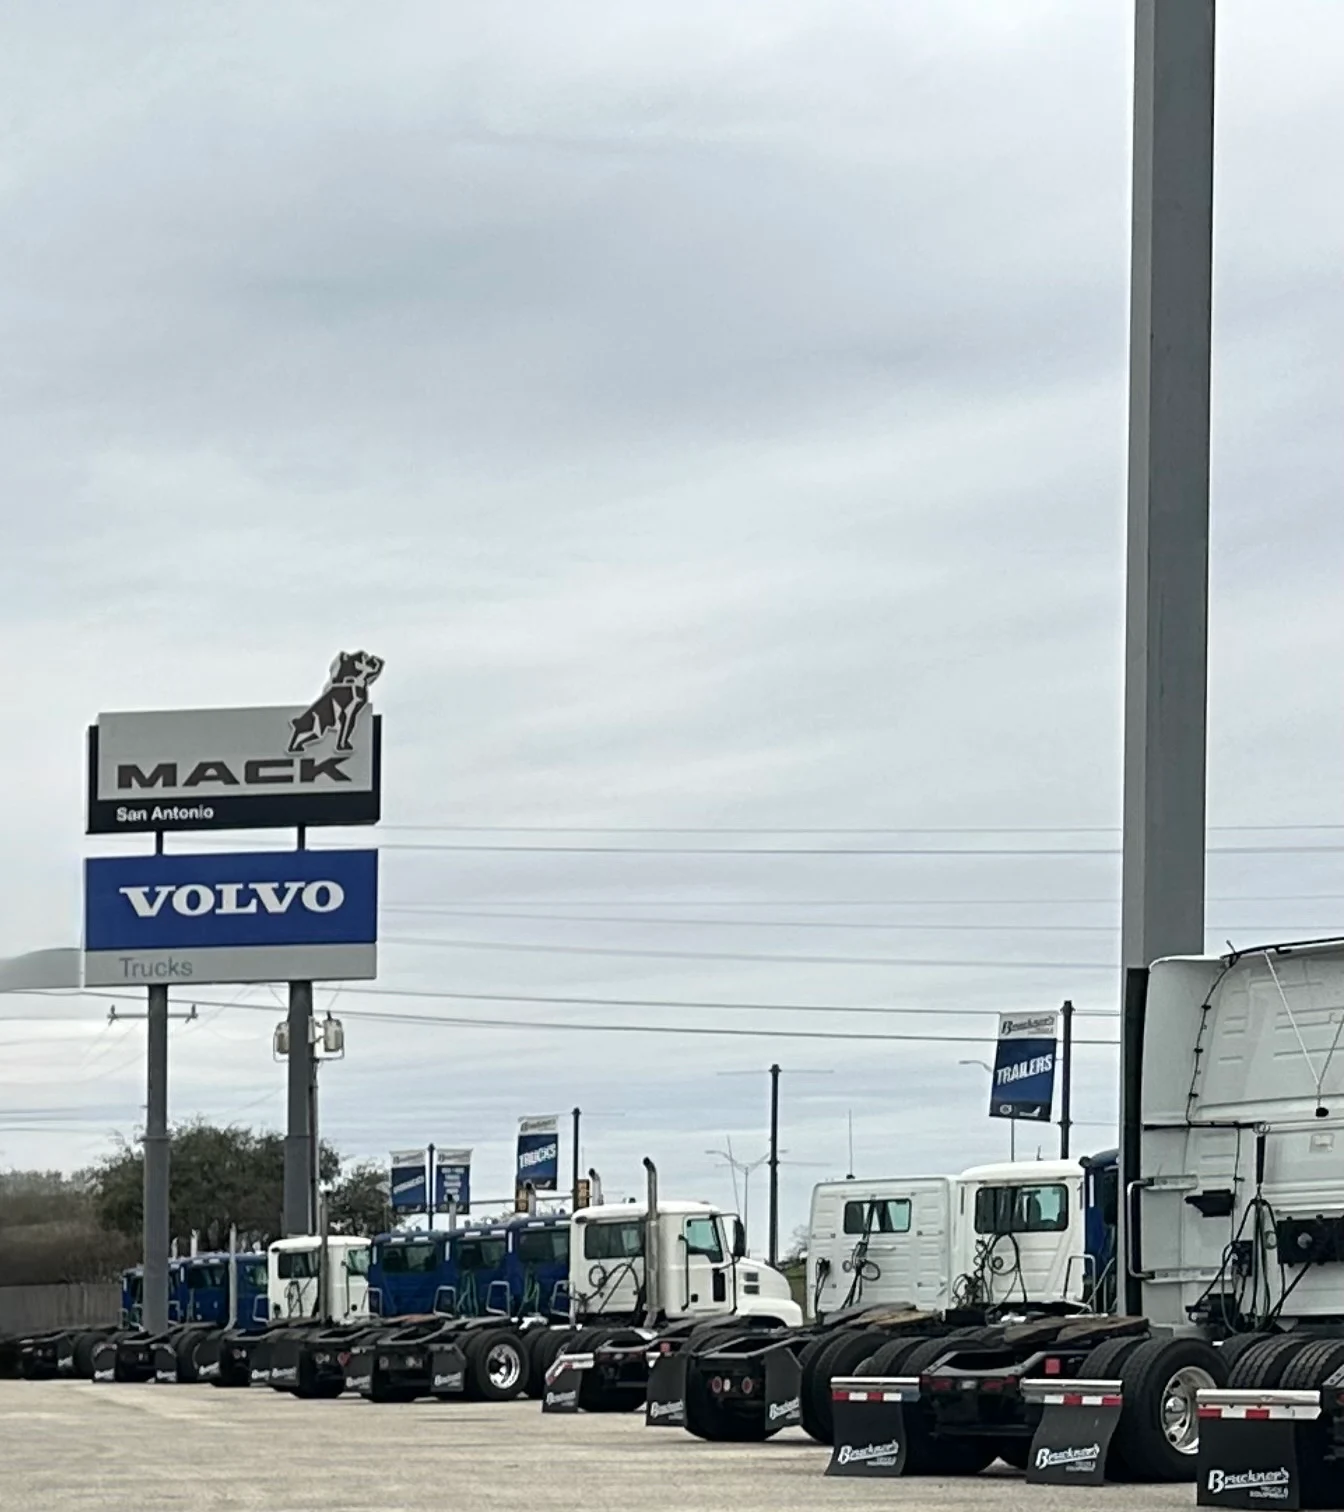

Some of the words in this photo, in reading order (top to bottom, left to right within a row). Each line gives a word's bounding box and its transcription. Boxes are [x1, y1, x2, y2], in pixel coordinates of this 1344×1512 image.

[117, 757, 353, 789] MACK
[116, 806, 148, 822] San
[151, 805, 214, 821] Antonio
[119, 880, 345, 917] VOLVO
[119, 957, 193, 978] Trucks
[996, 1053, 1053, 1086] TRAILERS
